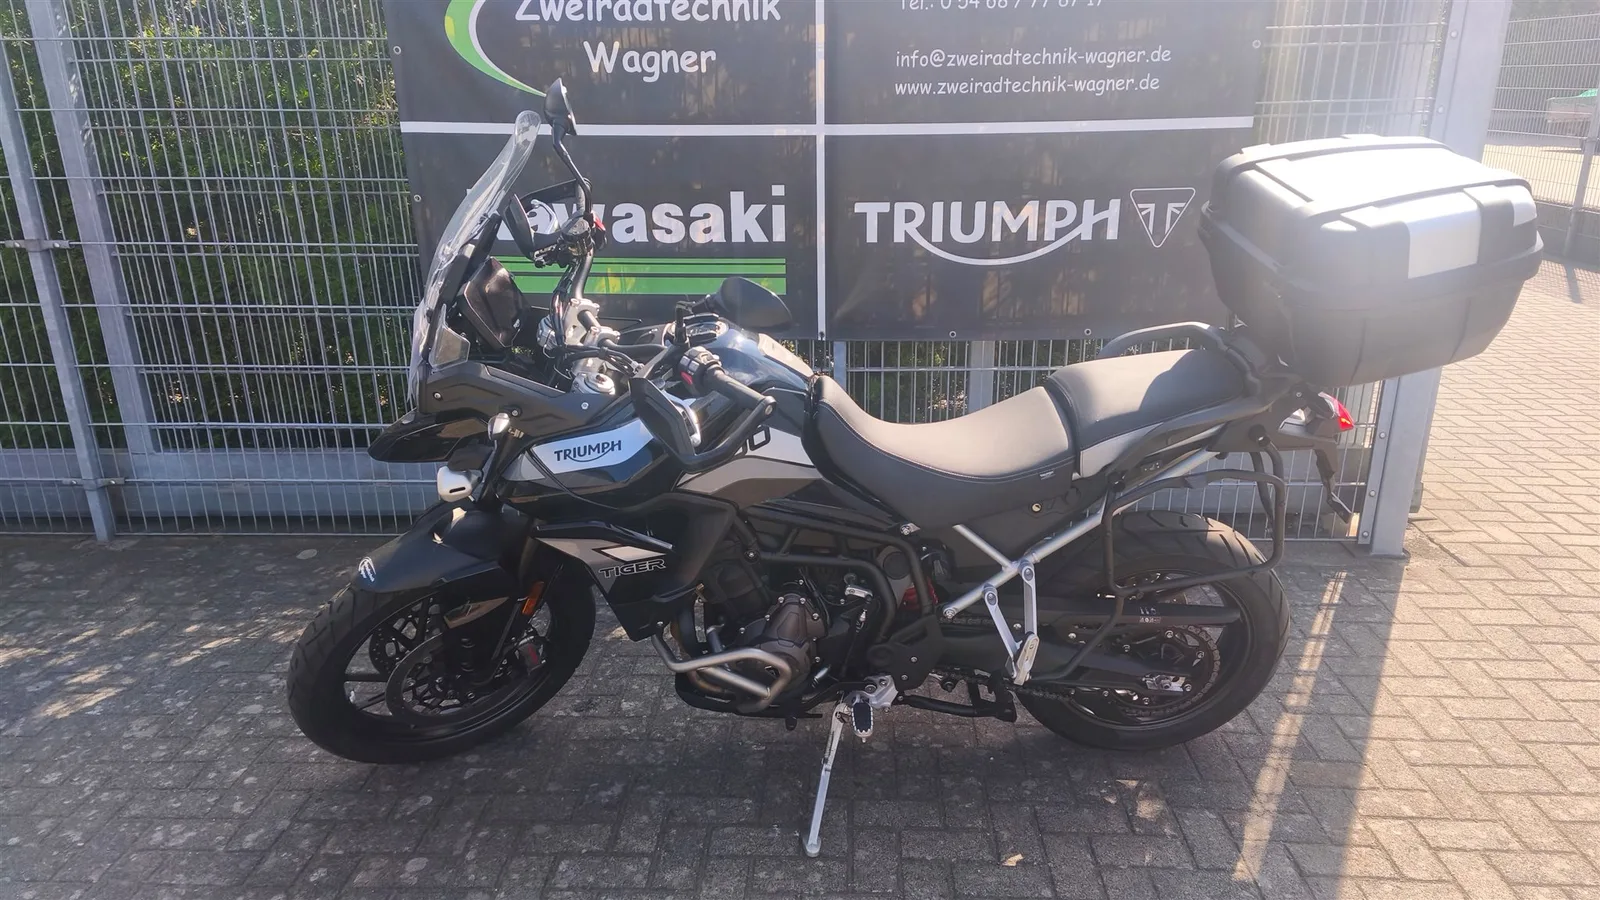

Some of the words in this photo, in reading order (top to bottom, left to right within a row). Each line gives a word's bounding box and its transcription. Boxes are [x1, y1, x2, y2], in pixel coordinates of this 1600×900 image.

[583, 41, 716, 82] Wagner
[895, 45, 1172, 69] info@zweiradtechnik-wagner.de
[894, 74, 1160, 96] www.zweiradtechnik-wagner.de
[854, 199, 1121, 265] TRIUMPH
[554, 440, 622, 462] TRIUMPH
[598, 559, 666, 579] TIGER
